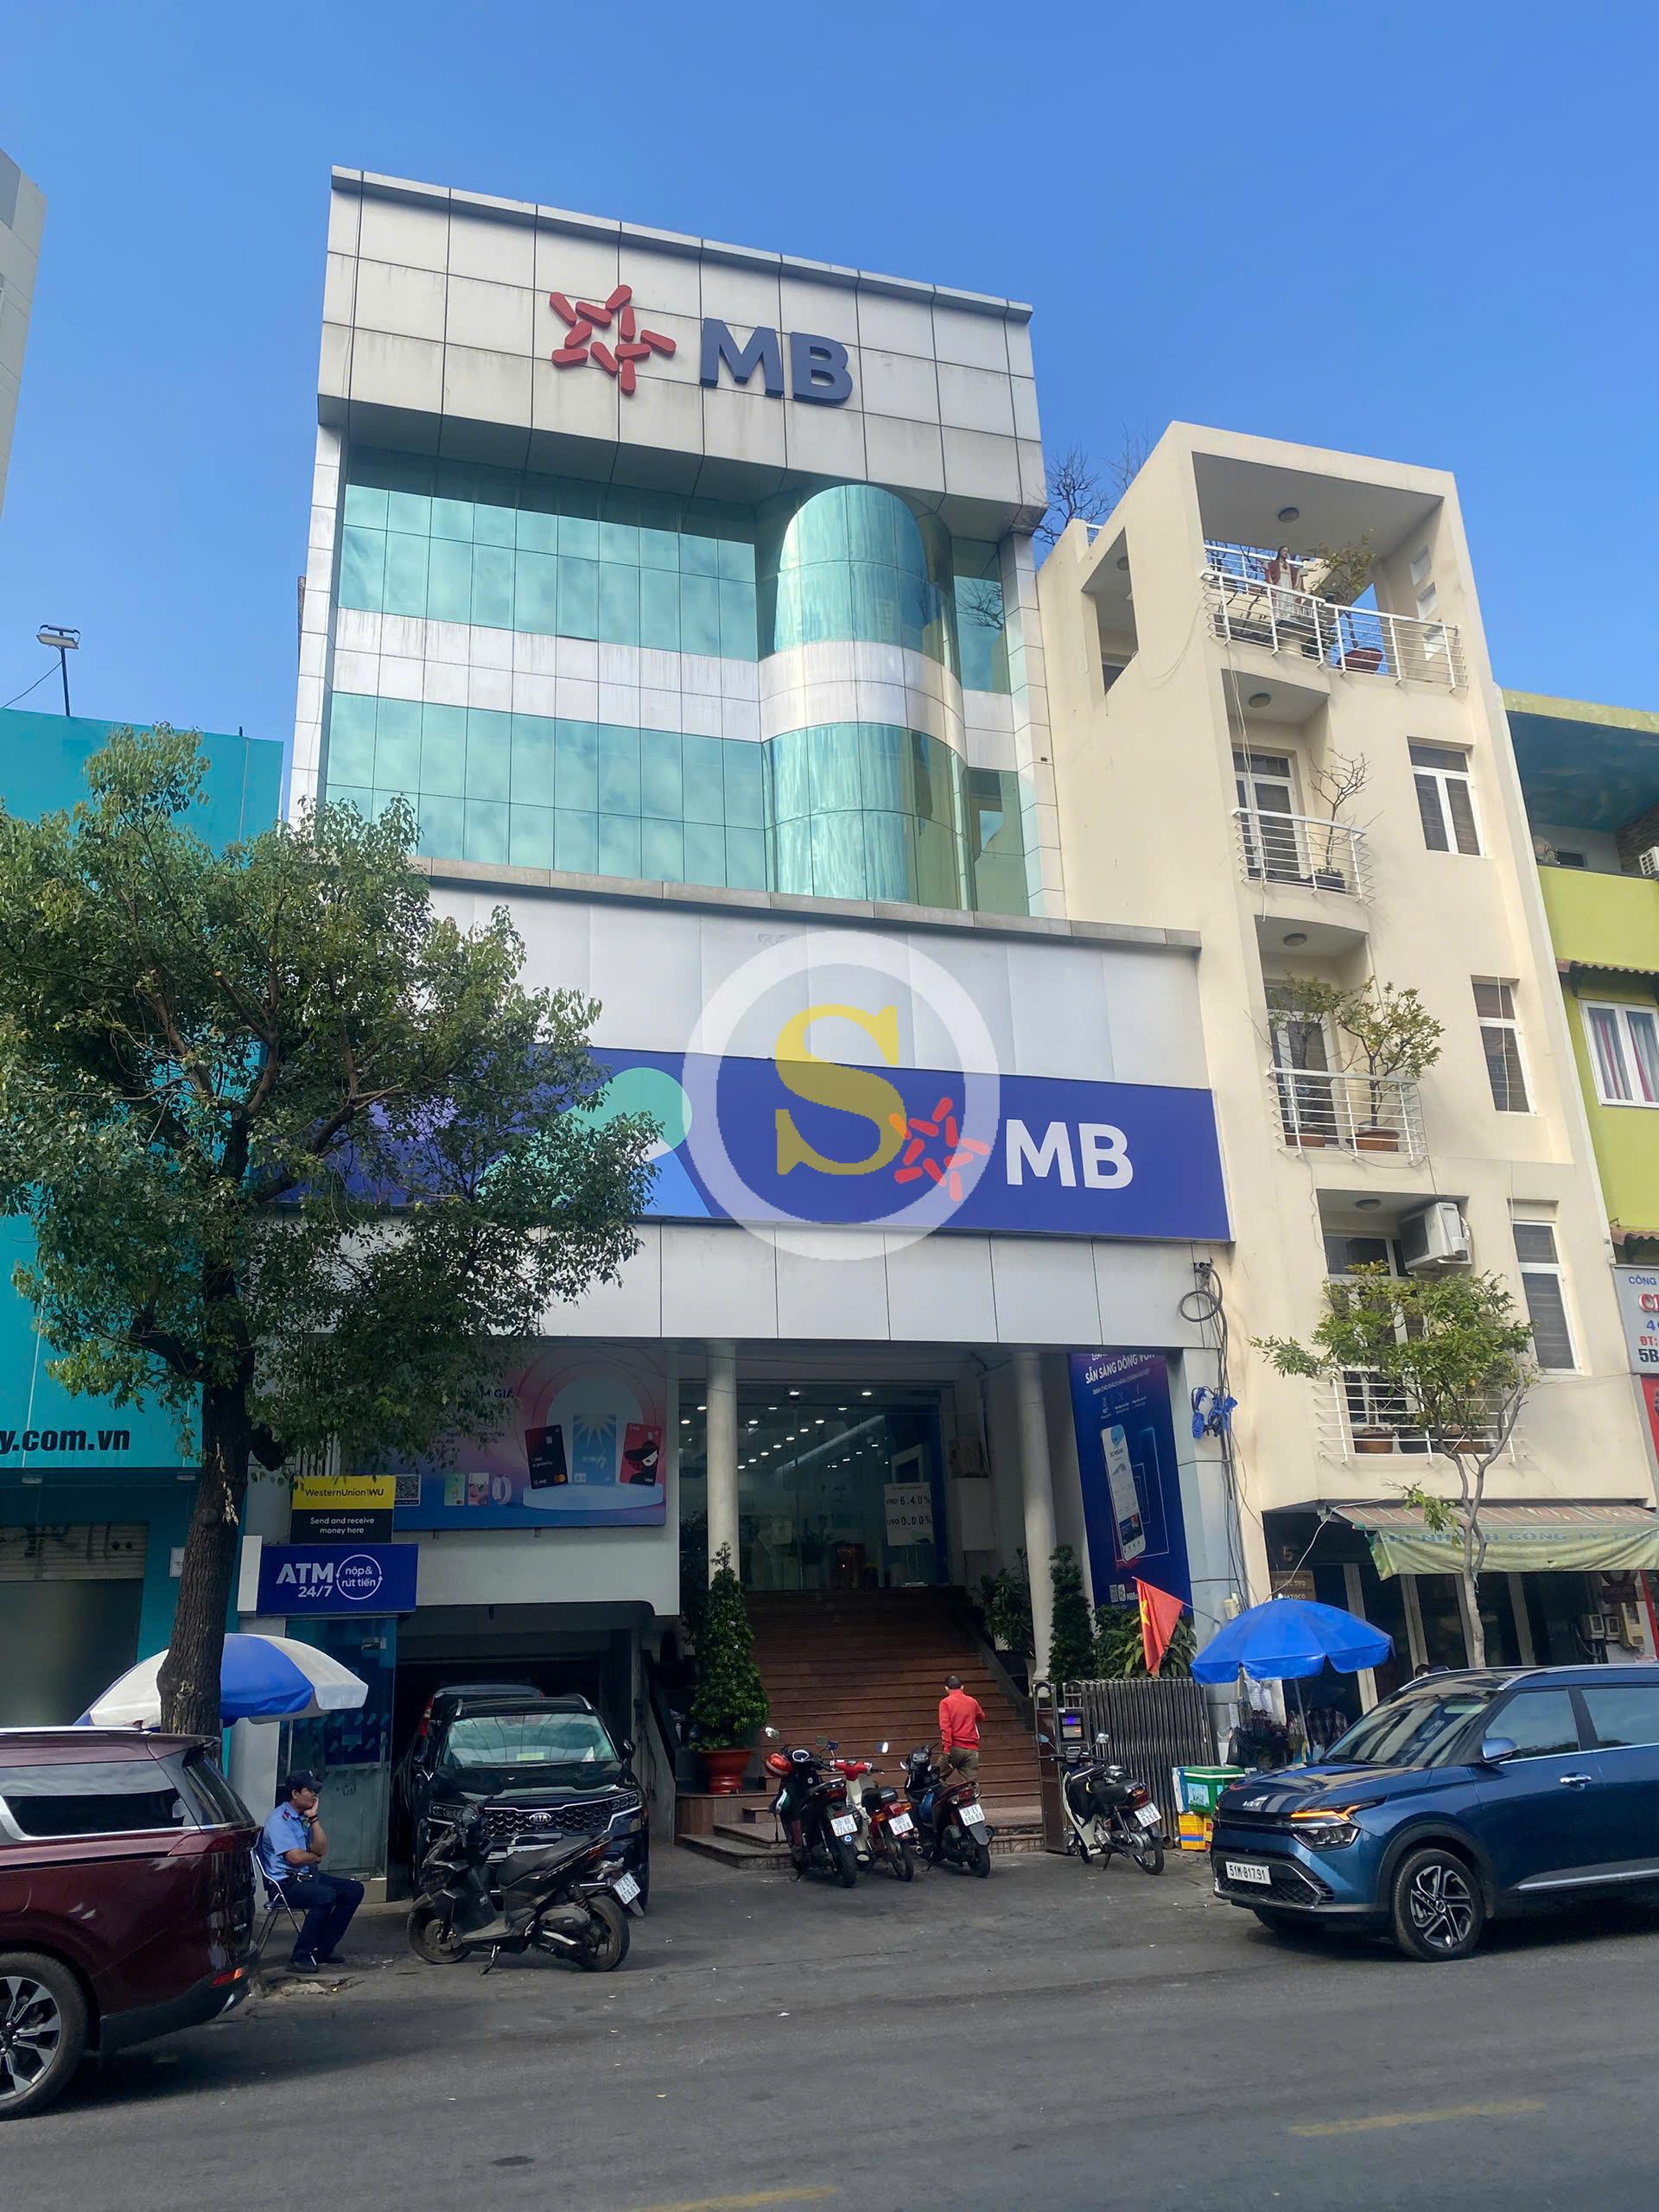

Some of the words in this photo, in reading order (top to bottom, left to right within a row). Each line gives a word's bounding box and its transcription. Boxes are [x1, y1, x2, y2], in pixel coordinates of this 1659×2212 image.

[700, 317, 854, 404] MB
[1005, 1119, 1134, 1190] MB
[1628, 1274, 1657, 1286] CÔNG
[0, 1429, 130, 1455] y.com.vn
[1507, 1529, 1568, 1542] CÔNG
[276, 1562, 334, 1585] ATM
[341, 1578, 356, 1586] rút
[298, 1586, 333, 1598] 24/7
